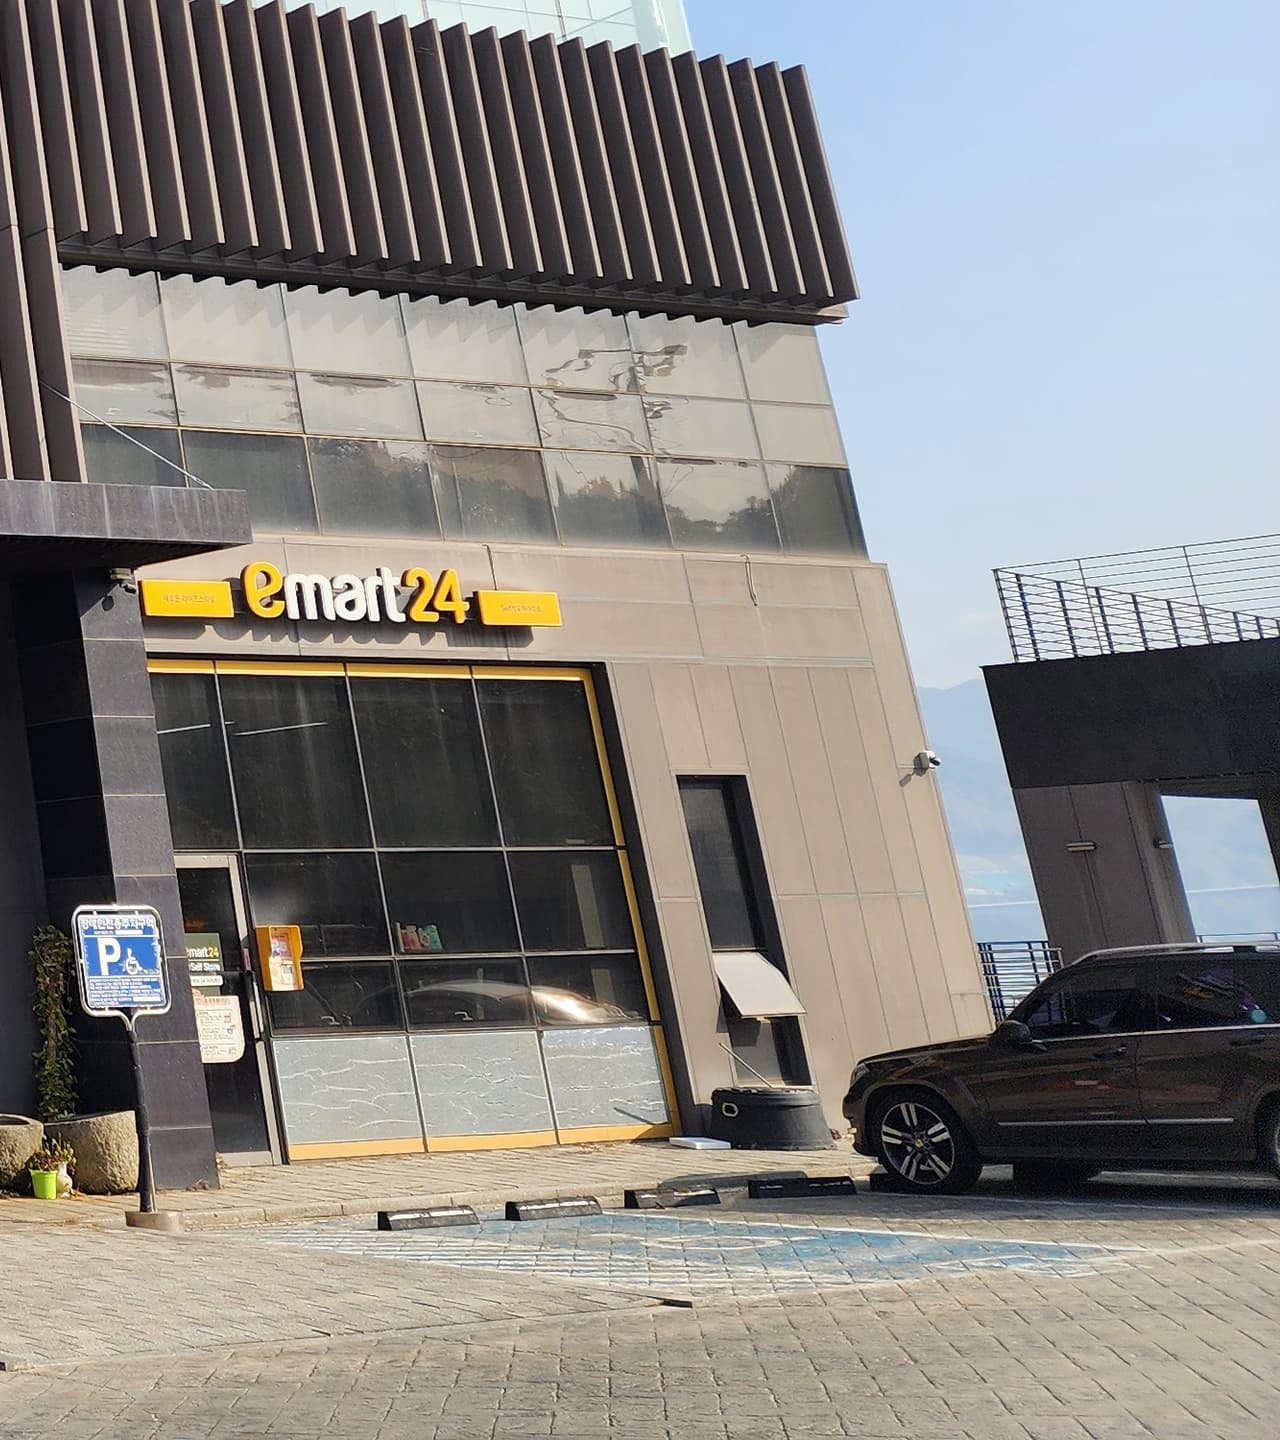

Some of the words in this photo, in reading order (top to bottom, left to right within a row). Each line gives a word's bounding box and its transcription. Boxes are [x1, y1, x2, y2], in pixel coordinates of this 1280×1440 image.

[241, 561, 469, 624] emart24
[97, 937, 121, 976] P
[186, 946, 220, 958] mart24
